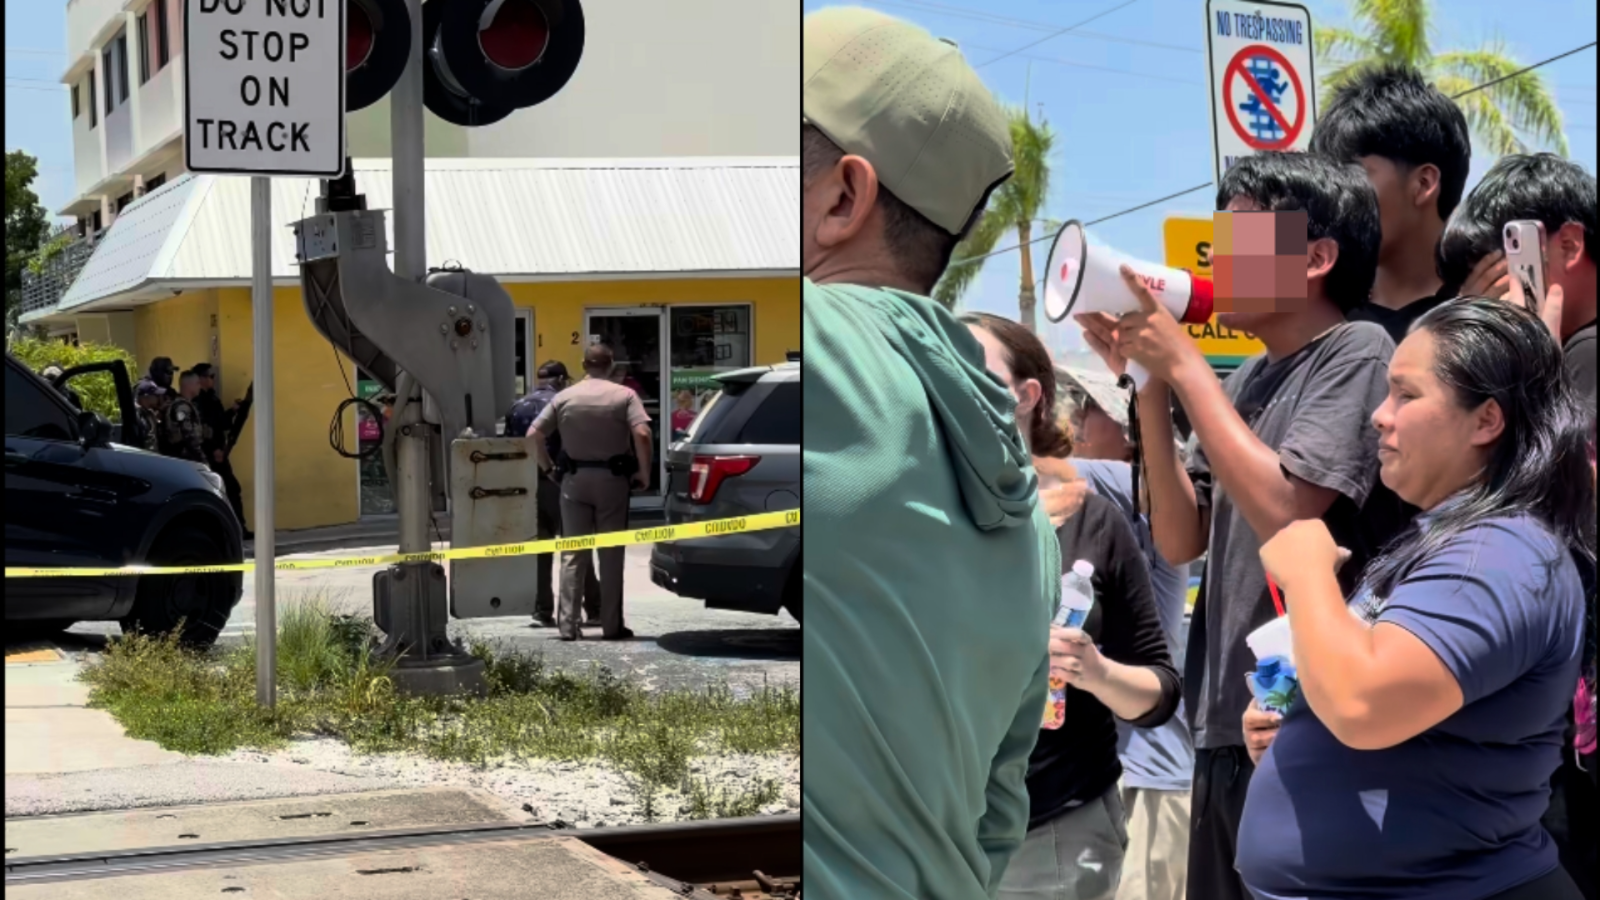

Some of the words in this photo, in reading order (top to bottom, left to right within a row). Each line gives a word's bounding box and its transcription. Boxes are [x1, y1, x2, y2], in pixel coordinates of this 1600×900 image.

[1216, 10, 1231, 37] NO
[1234, 13, 1303, 45] TRESPASSING
[219, 29, 310, 62] STOP
[240, 75, 289, 107] ON
[196, 119, 311, 152] TRACK
[570, 331, 580, 345] 2
